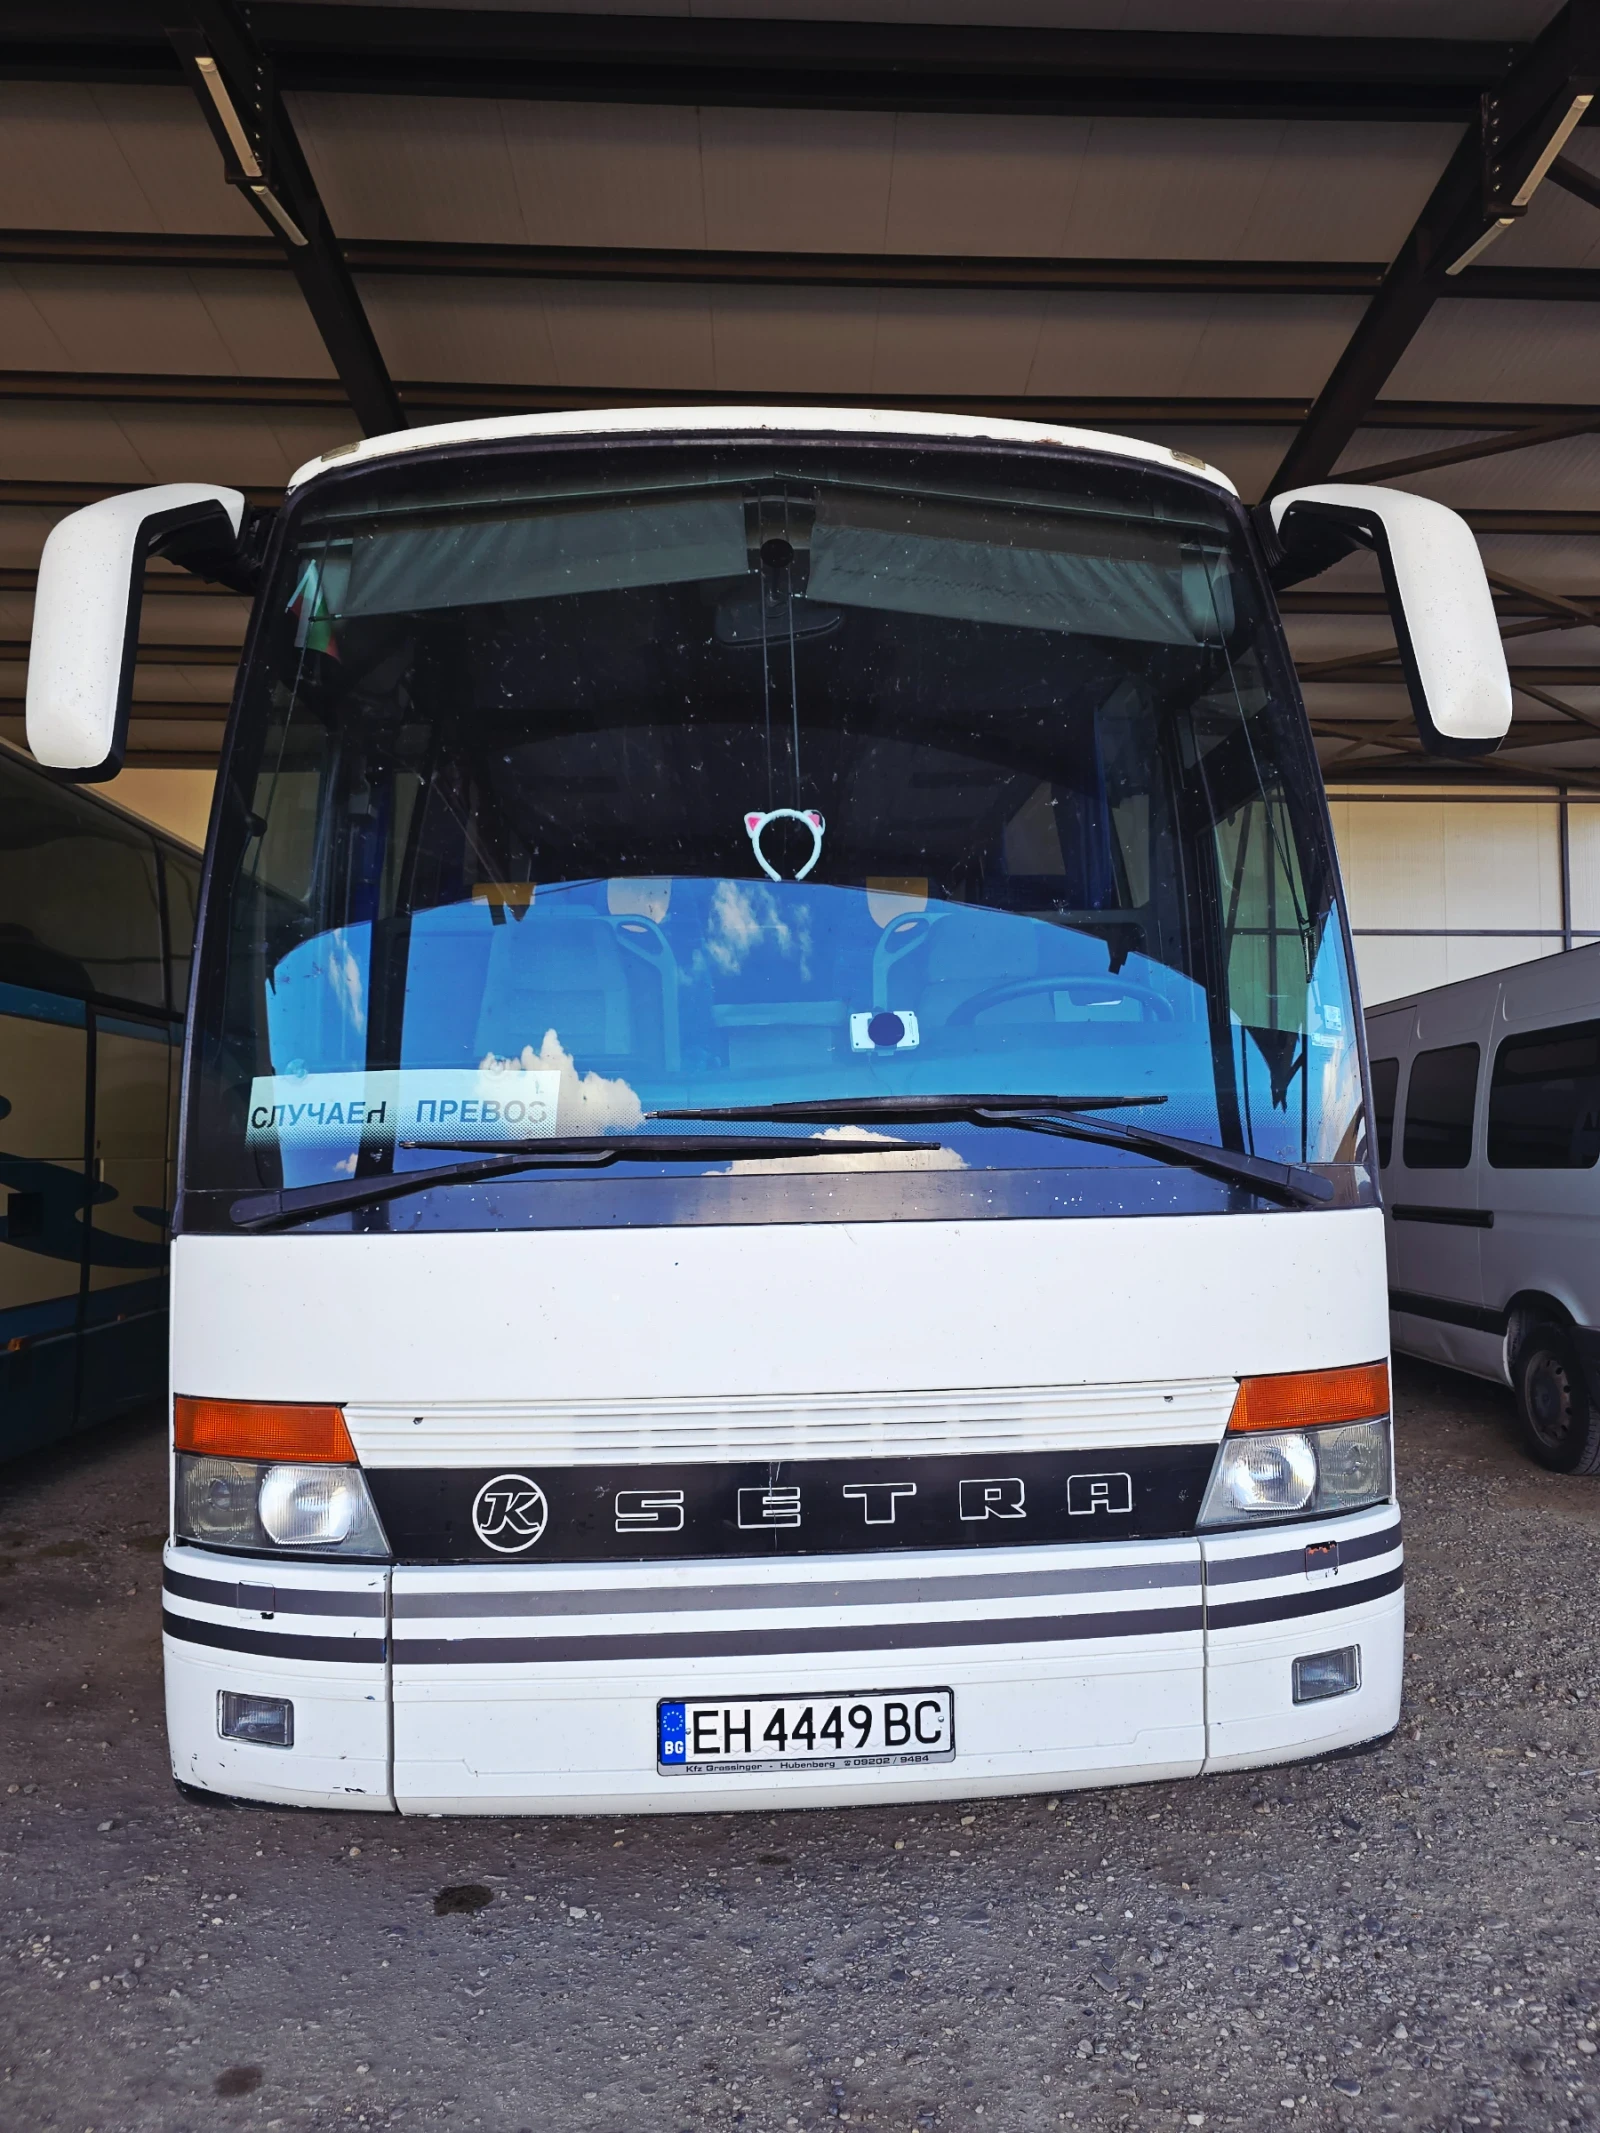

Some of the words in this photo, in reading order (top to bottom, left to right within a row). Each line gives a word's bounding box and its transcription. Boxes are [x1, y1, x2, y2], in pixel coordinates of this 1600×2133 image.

[615, 1473, 1132, 1533] SETRA
[693, 1709, 752, 1755] EH
[763, 1704, 872, 1751] 4449
[884, 1700, 942, 1747] BC
[664, 1741, 684, 1755] BG
[686, 1765, 702, 1773] Kfz
[900, 1755, 930, 1764] 9484
